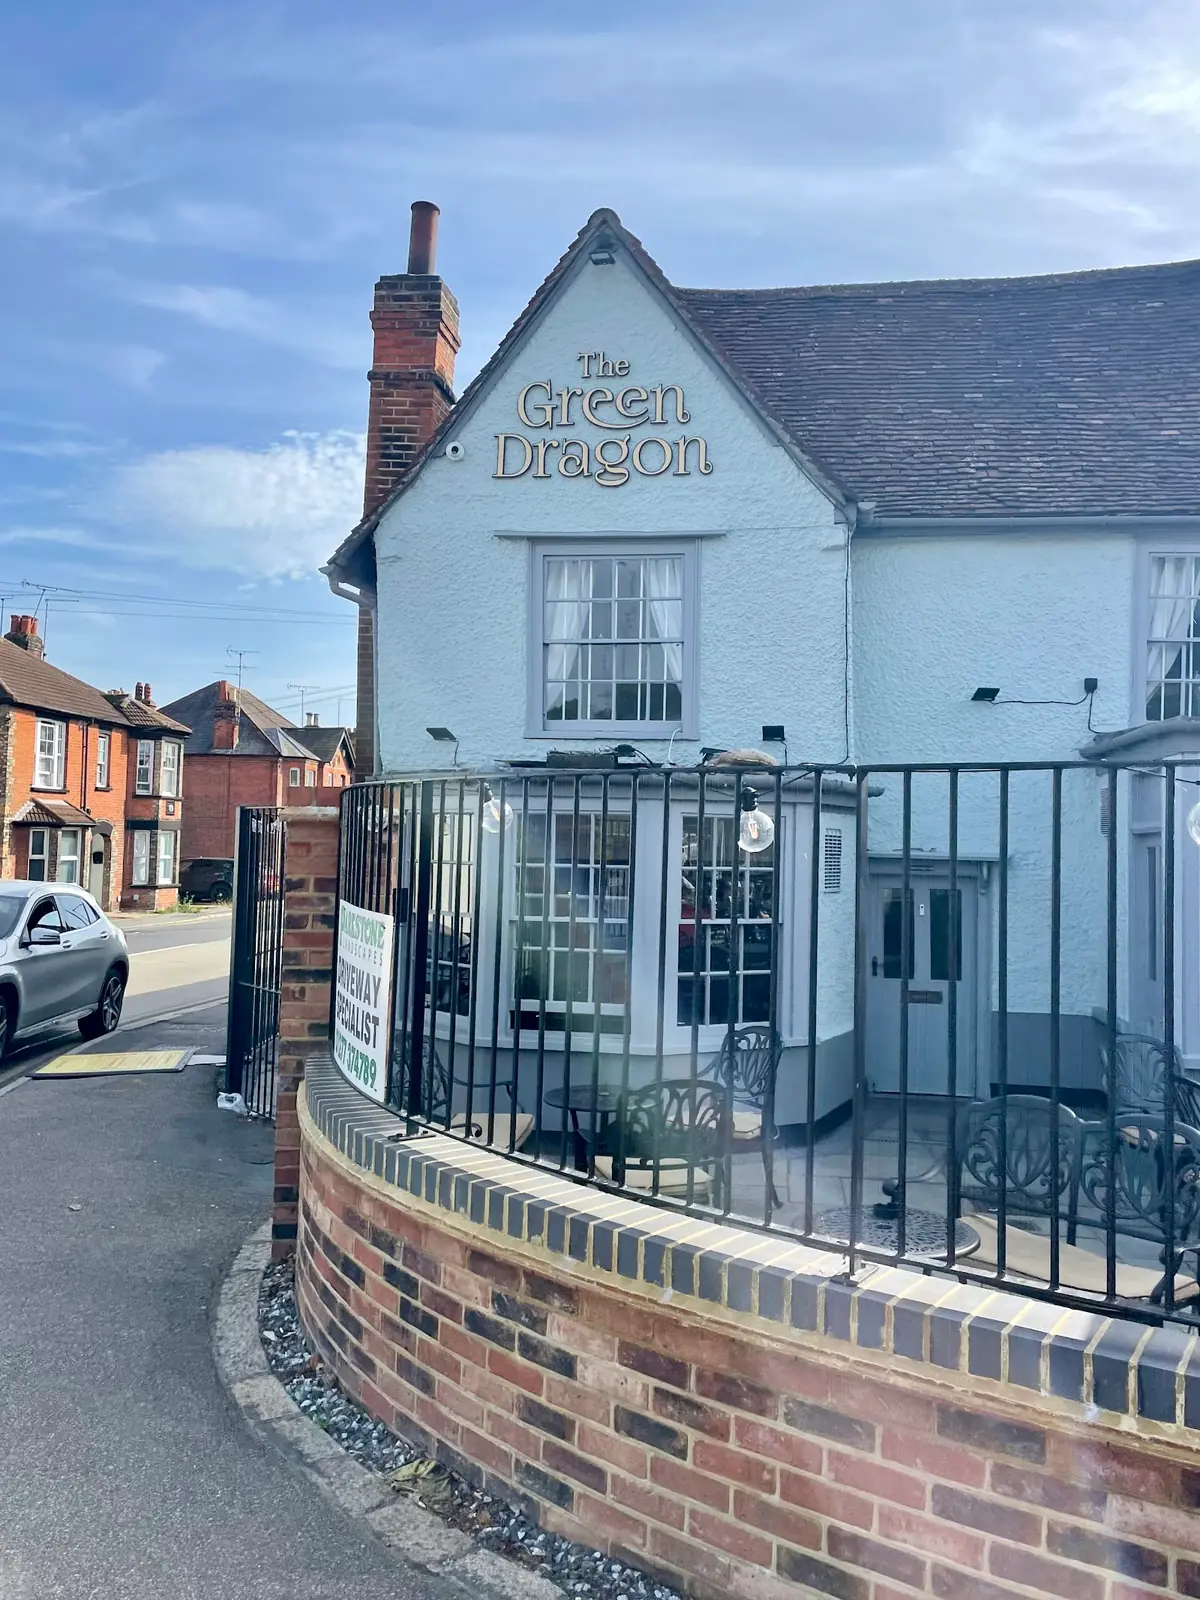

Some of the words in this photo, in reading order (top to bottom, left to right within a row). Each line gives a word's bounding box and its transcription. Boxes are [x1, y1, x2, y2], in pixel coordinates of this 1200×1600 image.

[577, 351, 630, 378] The
[516, 379, 691, 430] Green
[492, 433, 714, 487] Dragon
[338, 955, 381, 1009] DRIVEWAY
[336, 990, 380, 1049] SPECIALIST
[347, 1042, 376, 1088] 374789
